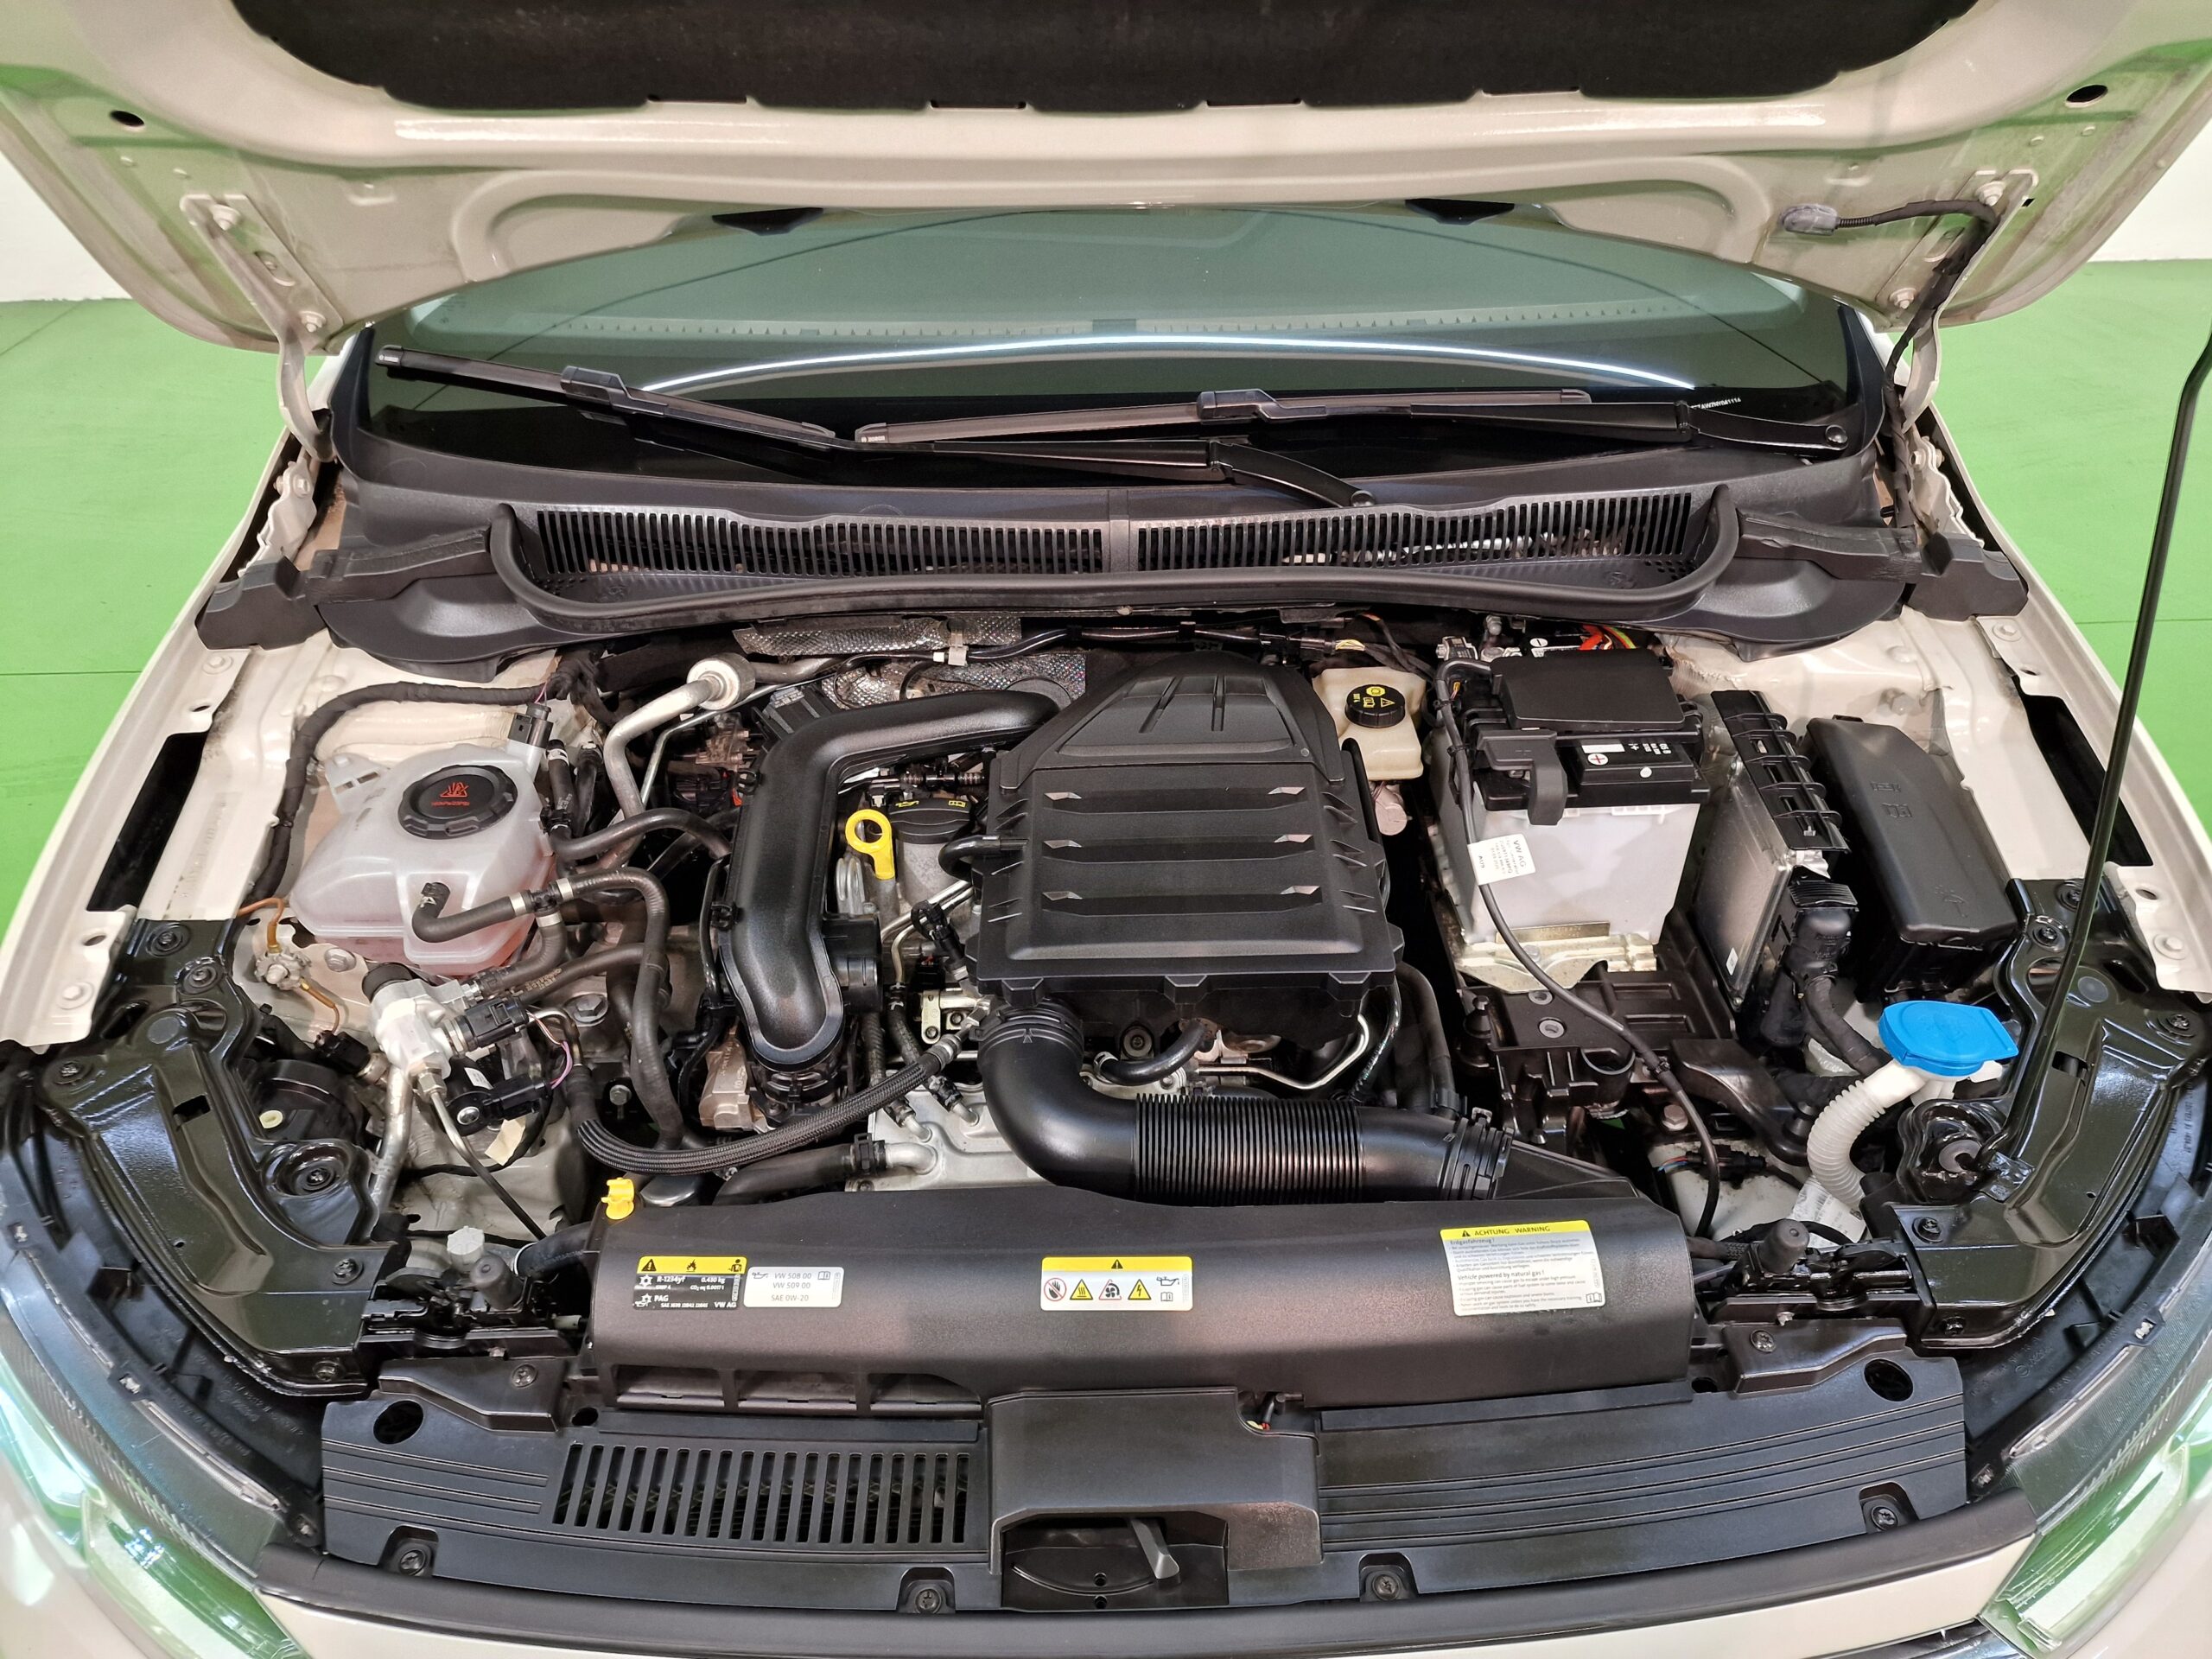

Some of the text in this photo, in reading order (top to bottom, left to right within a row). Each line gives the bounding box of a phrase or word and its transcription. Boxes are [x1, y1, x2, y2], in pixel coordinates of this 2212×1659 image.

[1513, 840, 1527, 868] VW AG
[656, 1275, 687, 1284] R-1234yf
[1478, 1272, 1503, 1281] powered
